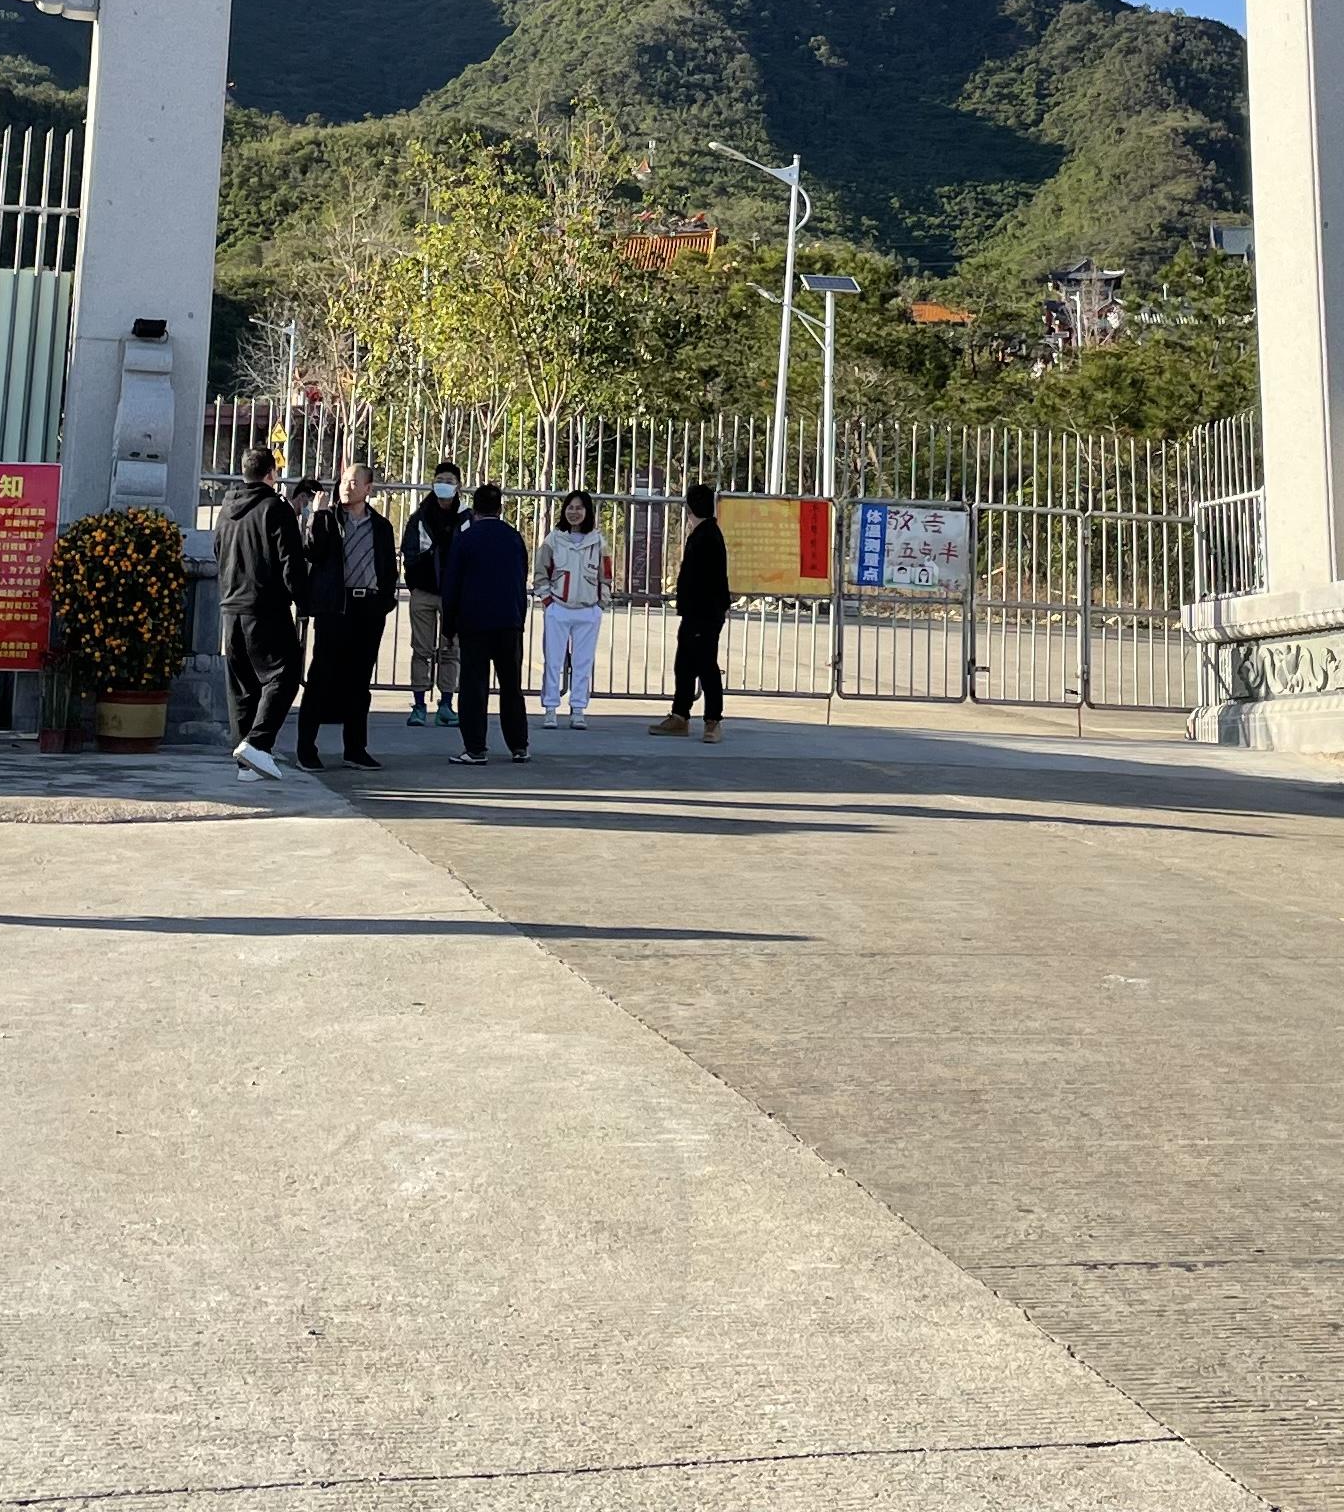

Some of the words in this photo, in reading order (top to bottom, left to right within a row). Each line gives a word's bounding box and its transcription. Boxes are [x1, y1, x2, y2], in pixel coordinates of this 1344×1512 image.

[861, 509, 882, 581] 体温测量点
